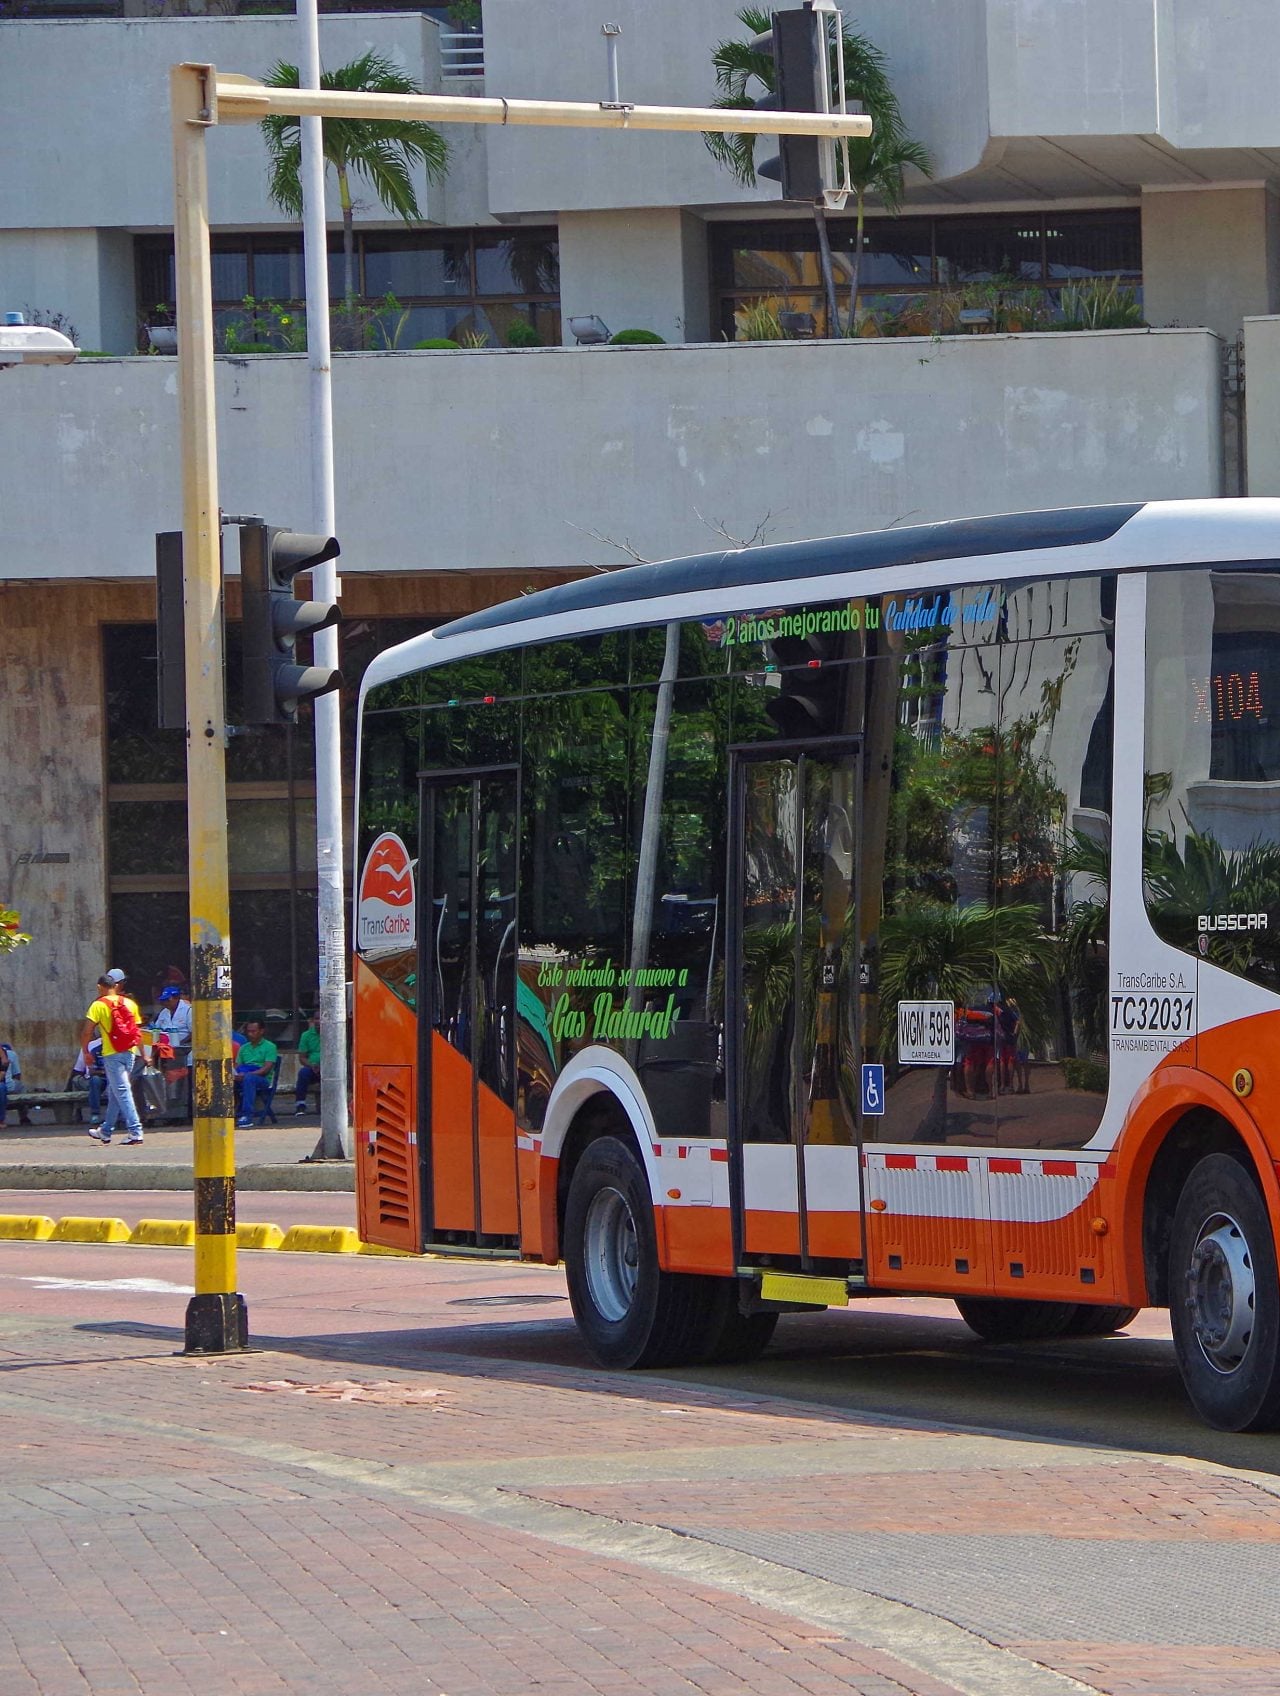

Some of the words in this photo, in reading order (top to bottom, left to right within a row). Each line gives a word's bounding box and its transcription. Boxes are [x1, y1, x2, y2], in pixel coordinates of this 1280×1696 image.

[725, 617, 736, 646] 2
[740, 613, 775, 644] años
[779, 602, 861, 640] mejorando
[865, 602, 880, 630] tu
[885, 595, 942, 632] Calidad
[1191, 671, 1264, 723] X104
[361, 913, 410, 936] TransCaribe
[1197, 913, 1268, 932] BUSSCAR
[538, 960, 563, 988] Este
[566, 958, 615, 988] vehículo
[618, 968, 633, 988] se
[635, 968, 675, 988] mueve
[678, 968, 689, 988] a
[1117, 972, 1167, 989] TransCaribe
[1169, 973, 1187, 989] S.A.
[552, 991, 587, 1043] Gas
[592, 991, 676, 1041] Natural
[900, 1010, 925, 1047] WGM
[929, 1010, 951, 1047] 596
[1111, 996, 1194, 1031] TC32031
[911, 1051, 941, 1060] CARTAGENA
[1112, 1039, 1171, 1052] TRANSAMBIENTAL
